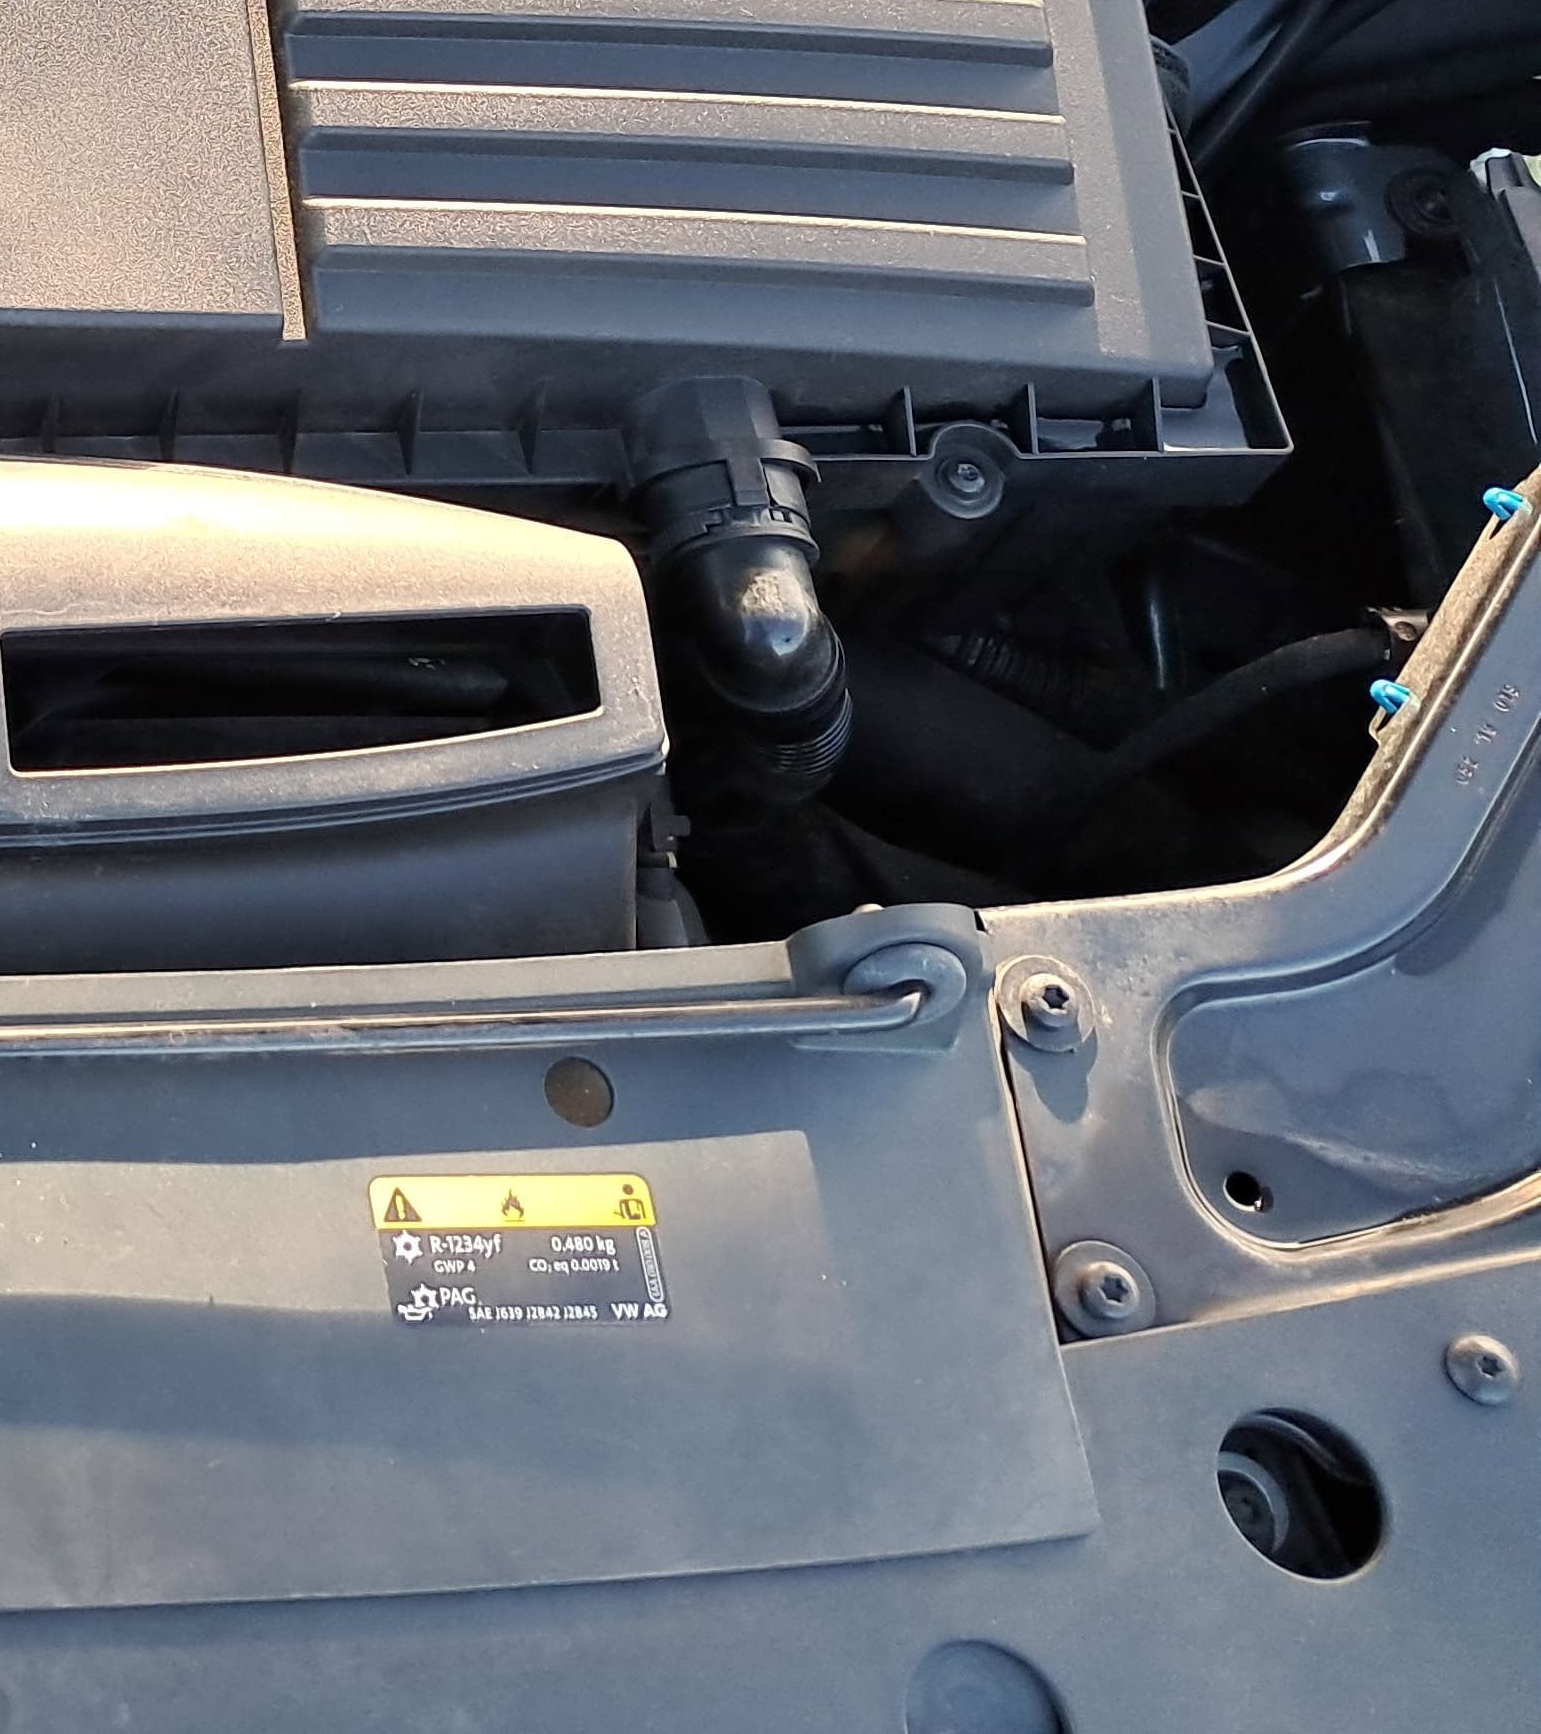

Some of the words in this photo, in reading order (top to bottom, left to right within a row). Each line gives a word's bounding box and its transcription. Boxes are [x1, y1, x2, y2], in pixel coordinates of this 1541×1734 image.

[429, 1234, 501, 1258] R-1234yf
[551, 1236, 593, 1252] 0.480
[596, 1235, 616, 1255] kg
[434, 1259, 464, 1273] GWP
[467, 1259, 476, 1272] 4
[553, 1260, 569, 1274] eq
[571, 1258, 610, 1272] 0.0019
[613, 1259, 620, 1271] t
[468, 1306, 492, 1320] SAE
[611, 1303, 639, 1320] VW
[643, 1302, 667, 1318] AG
